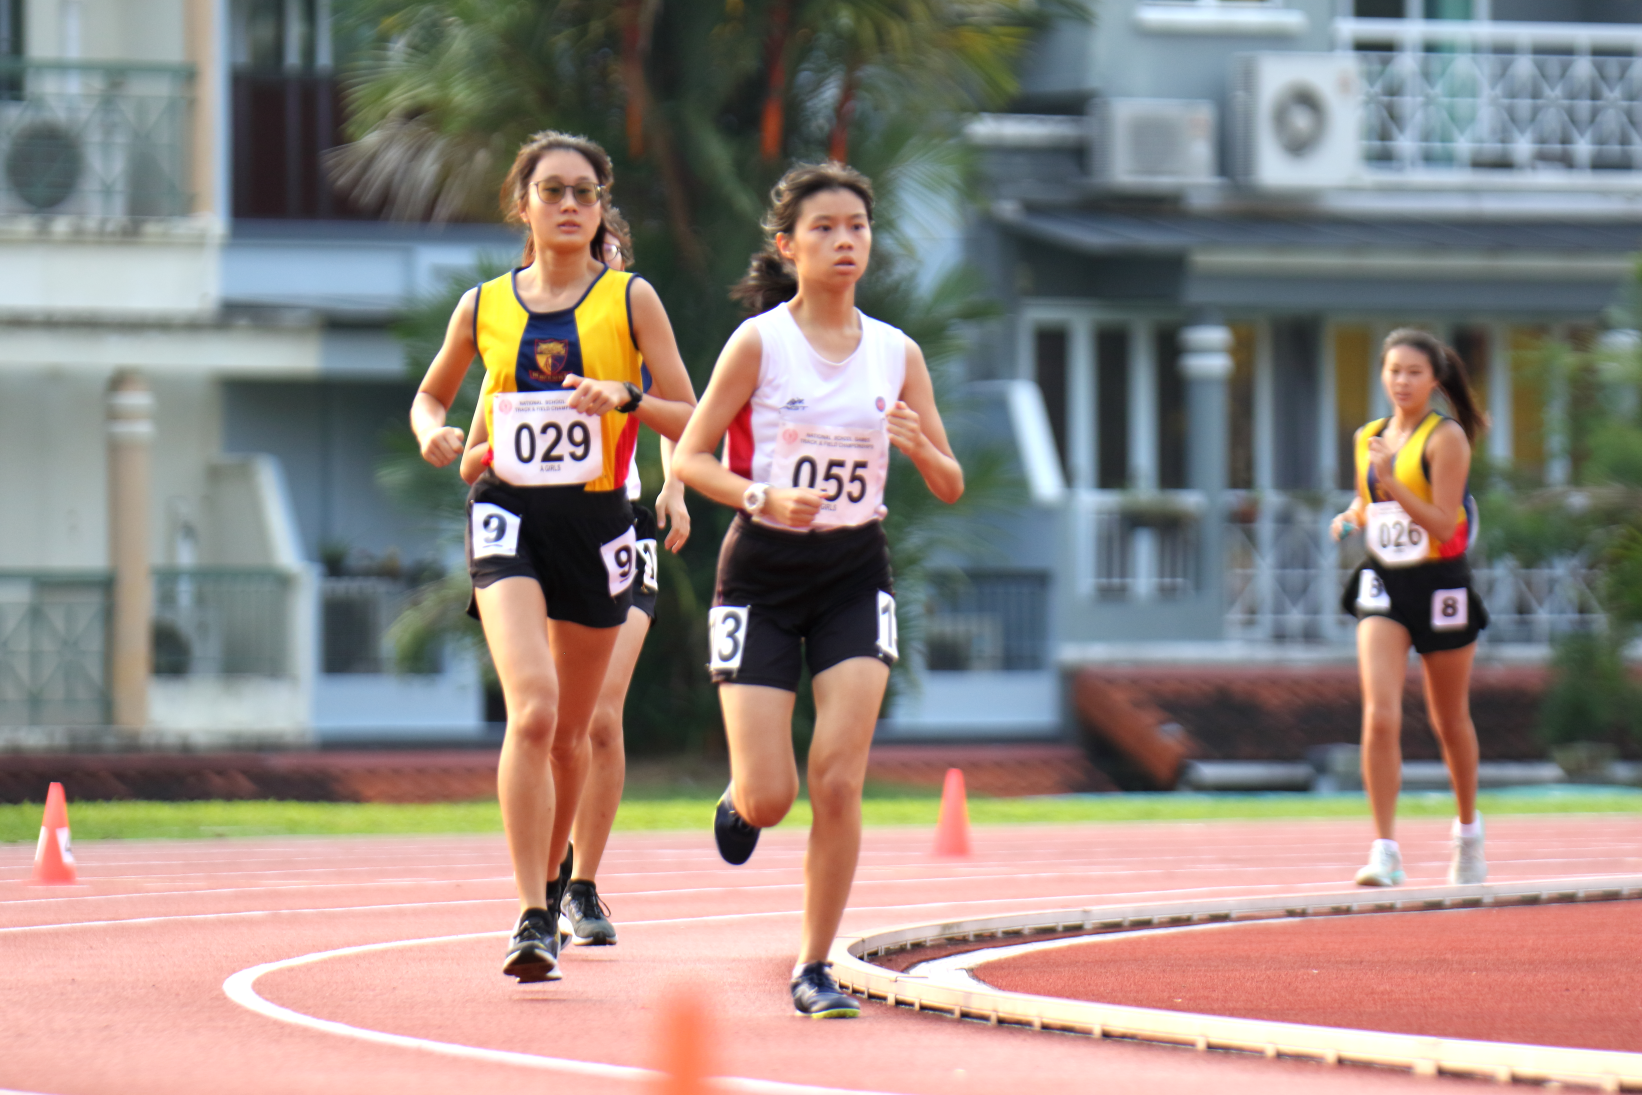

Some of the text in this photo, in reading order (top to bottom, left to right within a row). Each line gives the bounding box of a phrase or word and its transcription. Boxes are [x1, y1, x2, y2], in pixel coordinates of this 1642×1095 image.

[514, 420, 592, 464] 029
[545, 464, 561, 472] GIRLS
[792, 455, 868, 503] 055
[483, 513, 507, 543] 9
[1379, 520, 1422, 548] 026
[614, 544, 632, 578] 9
[1441, 596, 1458, 617] 8
